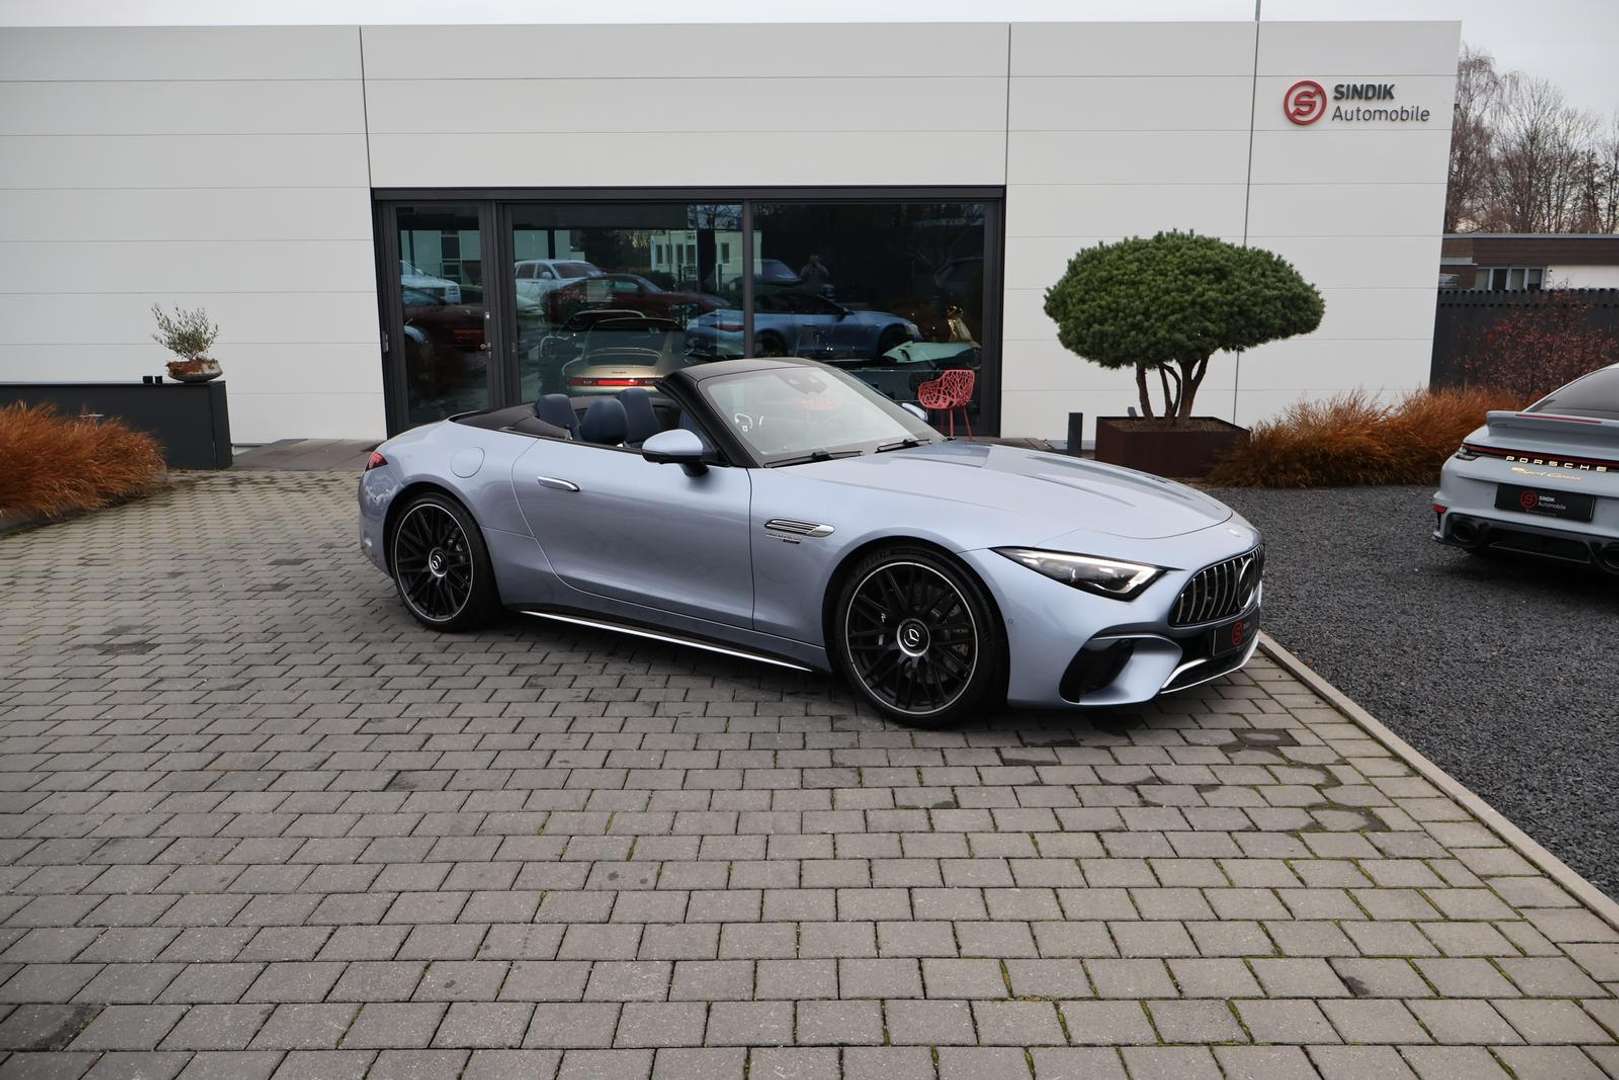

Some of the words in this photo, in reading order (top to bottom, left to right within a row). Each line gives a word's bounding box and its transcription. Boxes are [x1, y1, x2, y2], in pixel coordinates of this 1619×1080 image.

[1333, 84, 1395, 100] SINDIK
[1332, 105, 1430, 122] Automobile
[1505, 455, 1607, 472] PORSCHE
